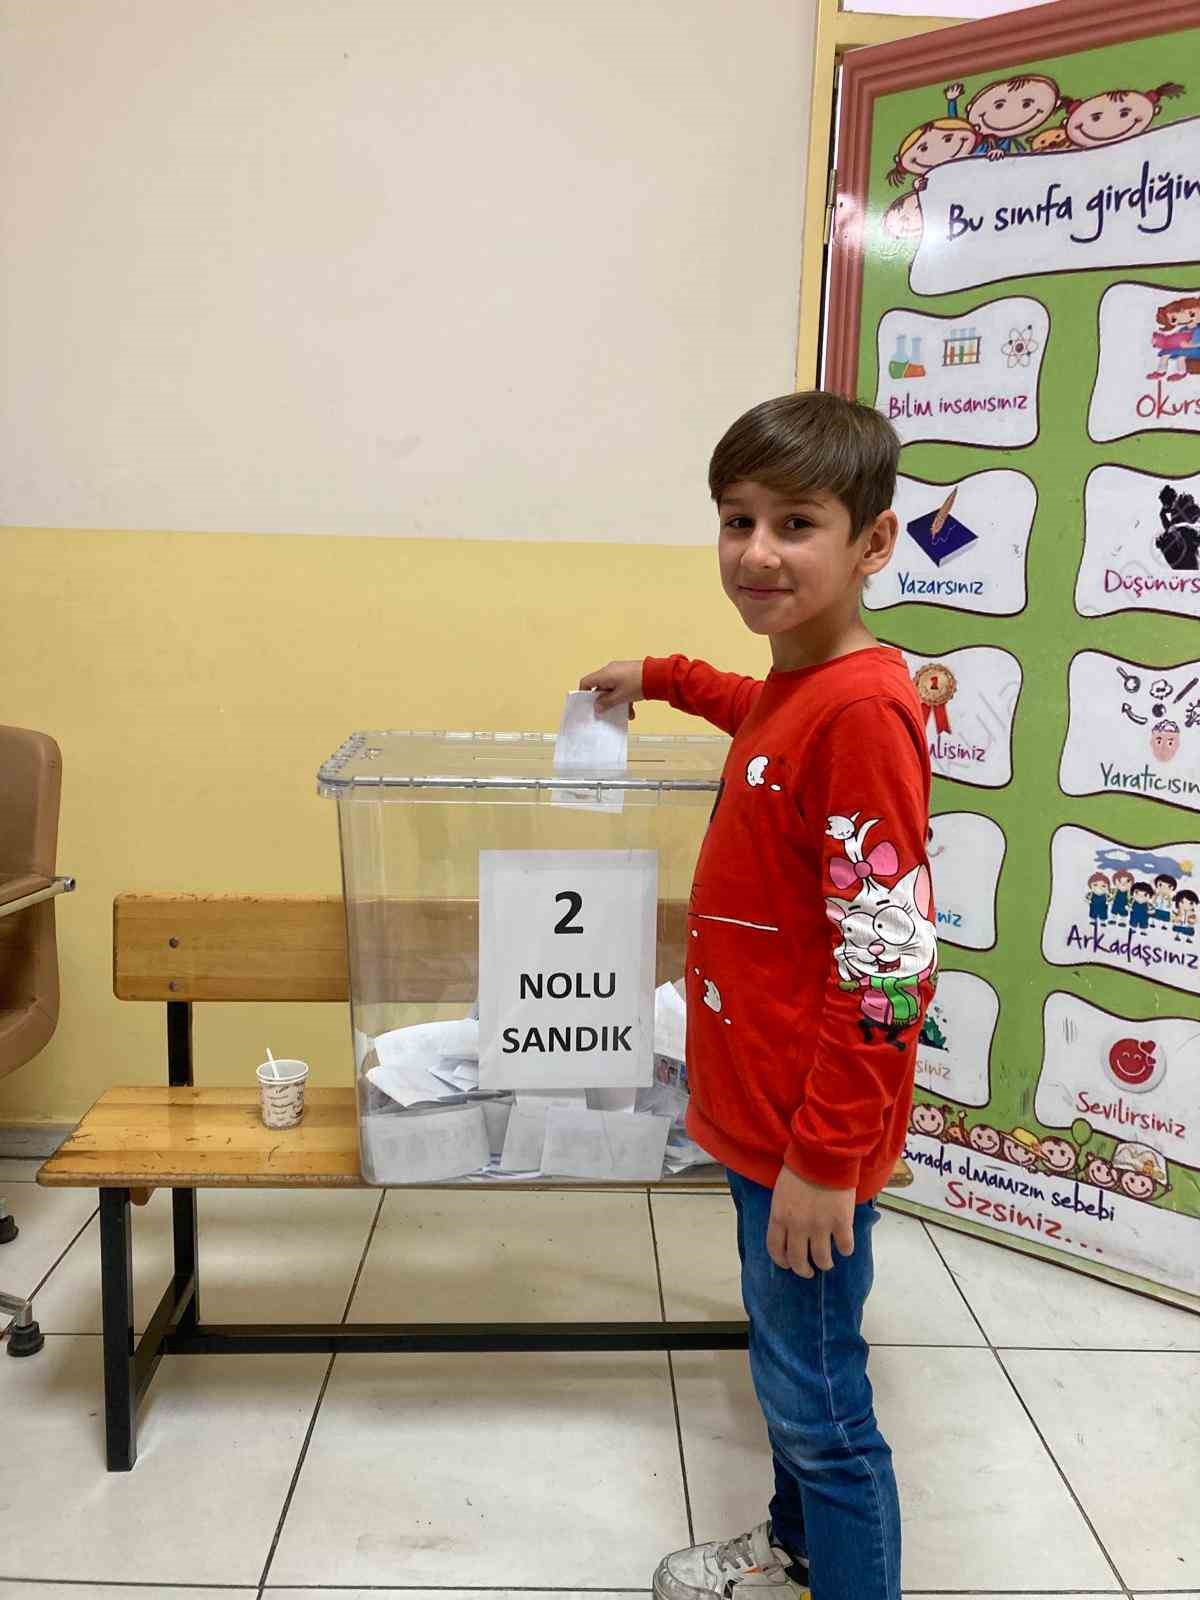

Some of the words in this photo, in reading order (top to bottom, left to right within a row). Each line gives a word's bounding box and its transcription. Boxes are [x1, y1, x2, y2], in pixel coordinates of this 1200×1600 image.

[948, 202, 984, 240] Bu
[995, 183, 1073, 231] sınıfa
[898, 572, 984, 595] Yazarsınız
[554, 890, 584, 934] 2
[520, 972, 616, 999] NOLU
[502, 1025, 632, 1053] SANDIK
[1075, 1091, 1187, 1138] Sevilirsiniz
[1051, 1182, 1115, 1221] sebebi
